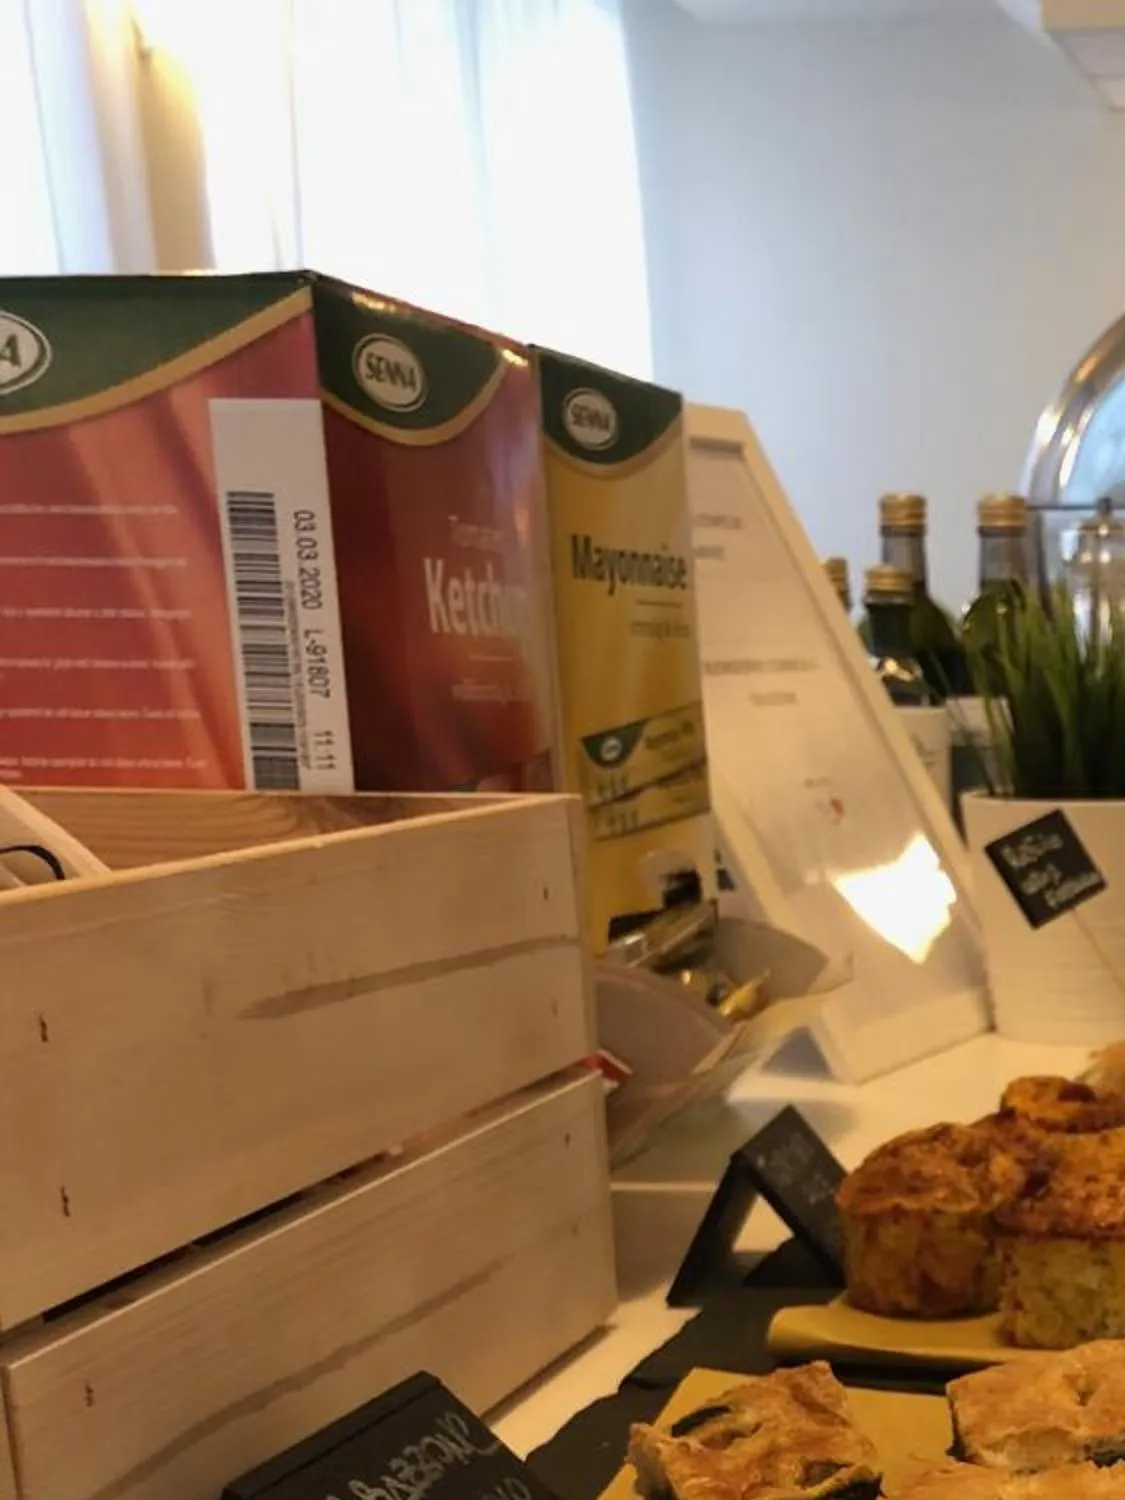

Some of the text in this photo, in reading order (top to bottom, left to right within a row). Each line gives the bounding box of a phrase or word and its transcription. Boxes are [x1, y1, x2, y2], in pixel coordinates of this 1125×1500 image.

[364, 353, 417, 393] SENNA
[570, 403, 611, 432] SENNA
[570, 533, 688, 596] Mayonnaise
